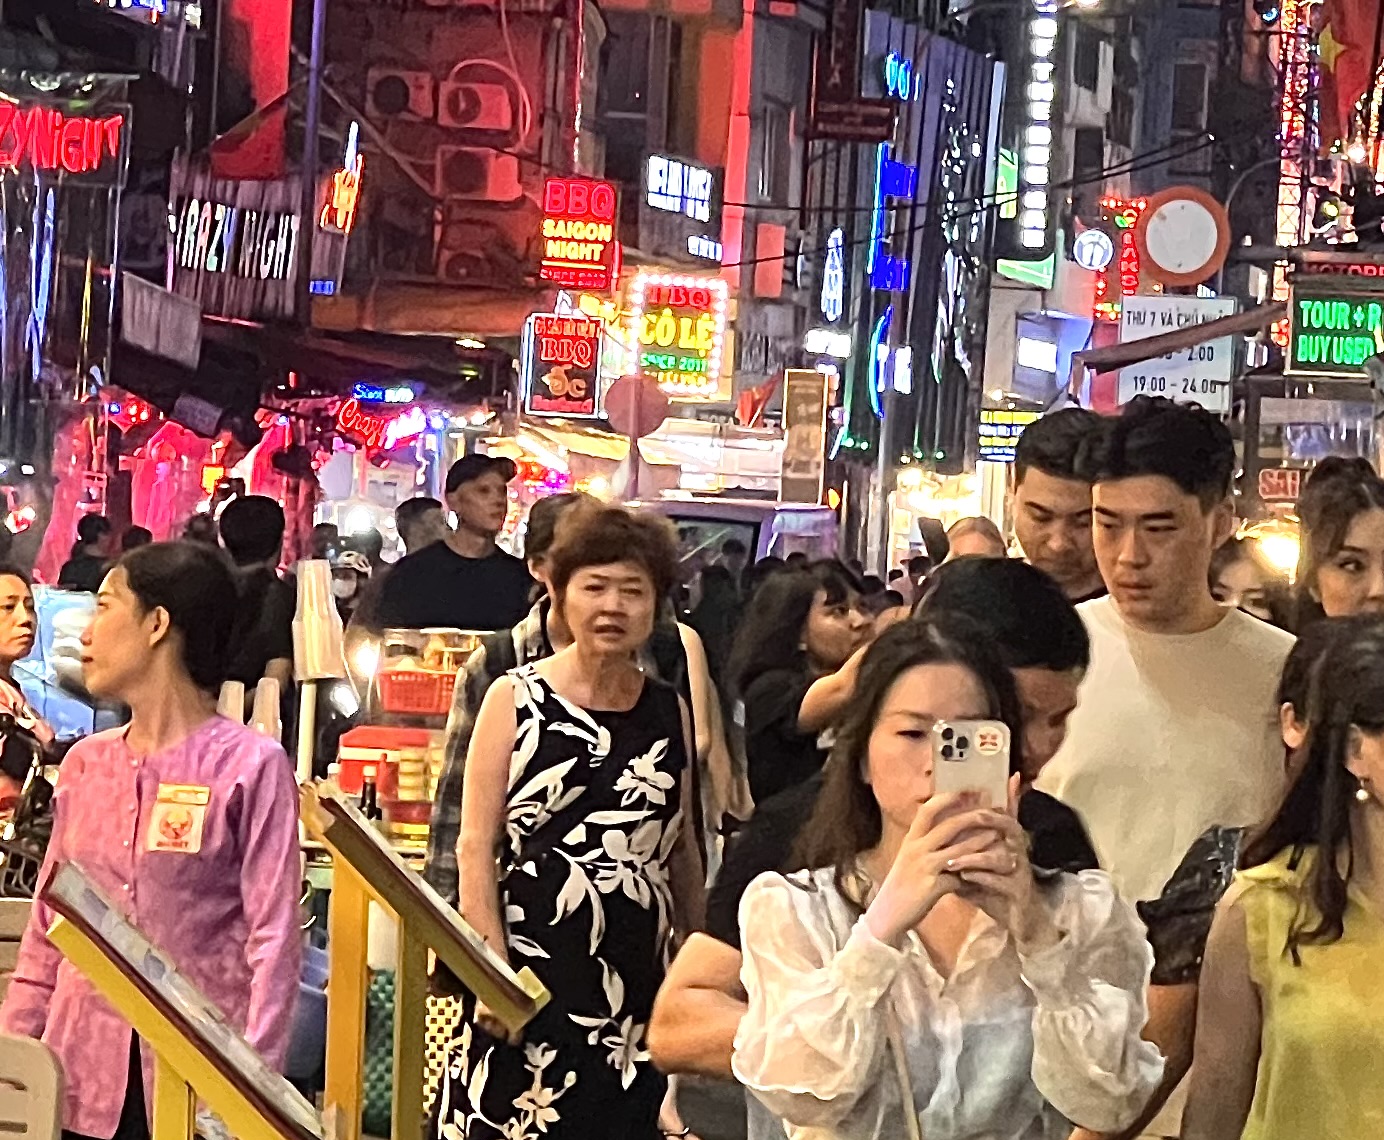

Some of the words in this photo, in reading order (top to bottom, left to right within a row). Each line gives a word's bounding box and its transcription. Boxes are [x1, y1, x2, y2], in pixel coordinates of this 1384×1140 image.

[544, 180, 615, 219] BBQ
[542, 218, 612, 242] SAIGON
[546, 240, 604, 261] NIGHT
[1299, 300, 1350, 330] TOUR
[540, 337, 592, 368] BBQ
[1297, 334, 1332, 363] BUY
[1133, 375, 1166, 392] 19.00
